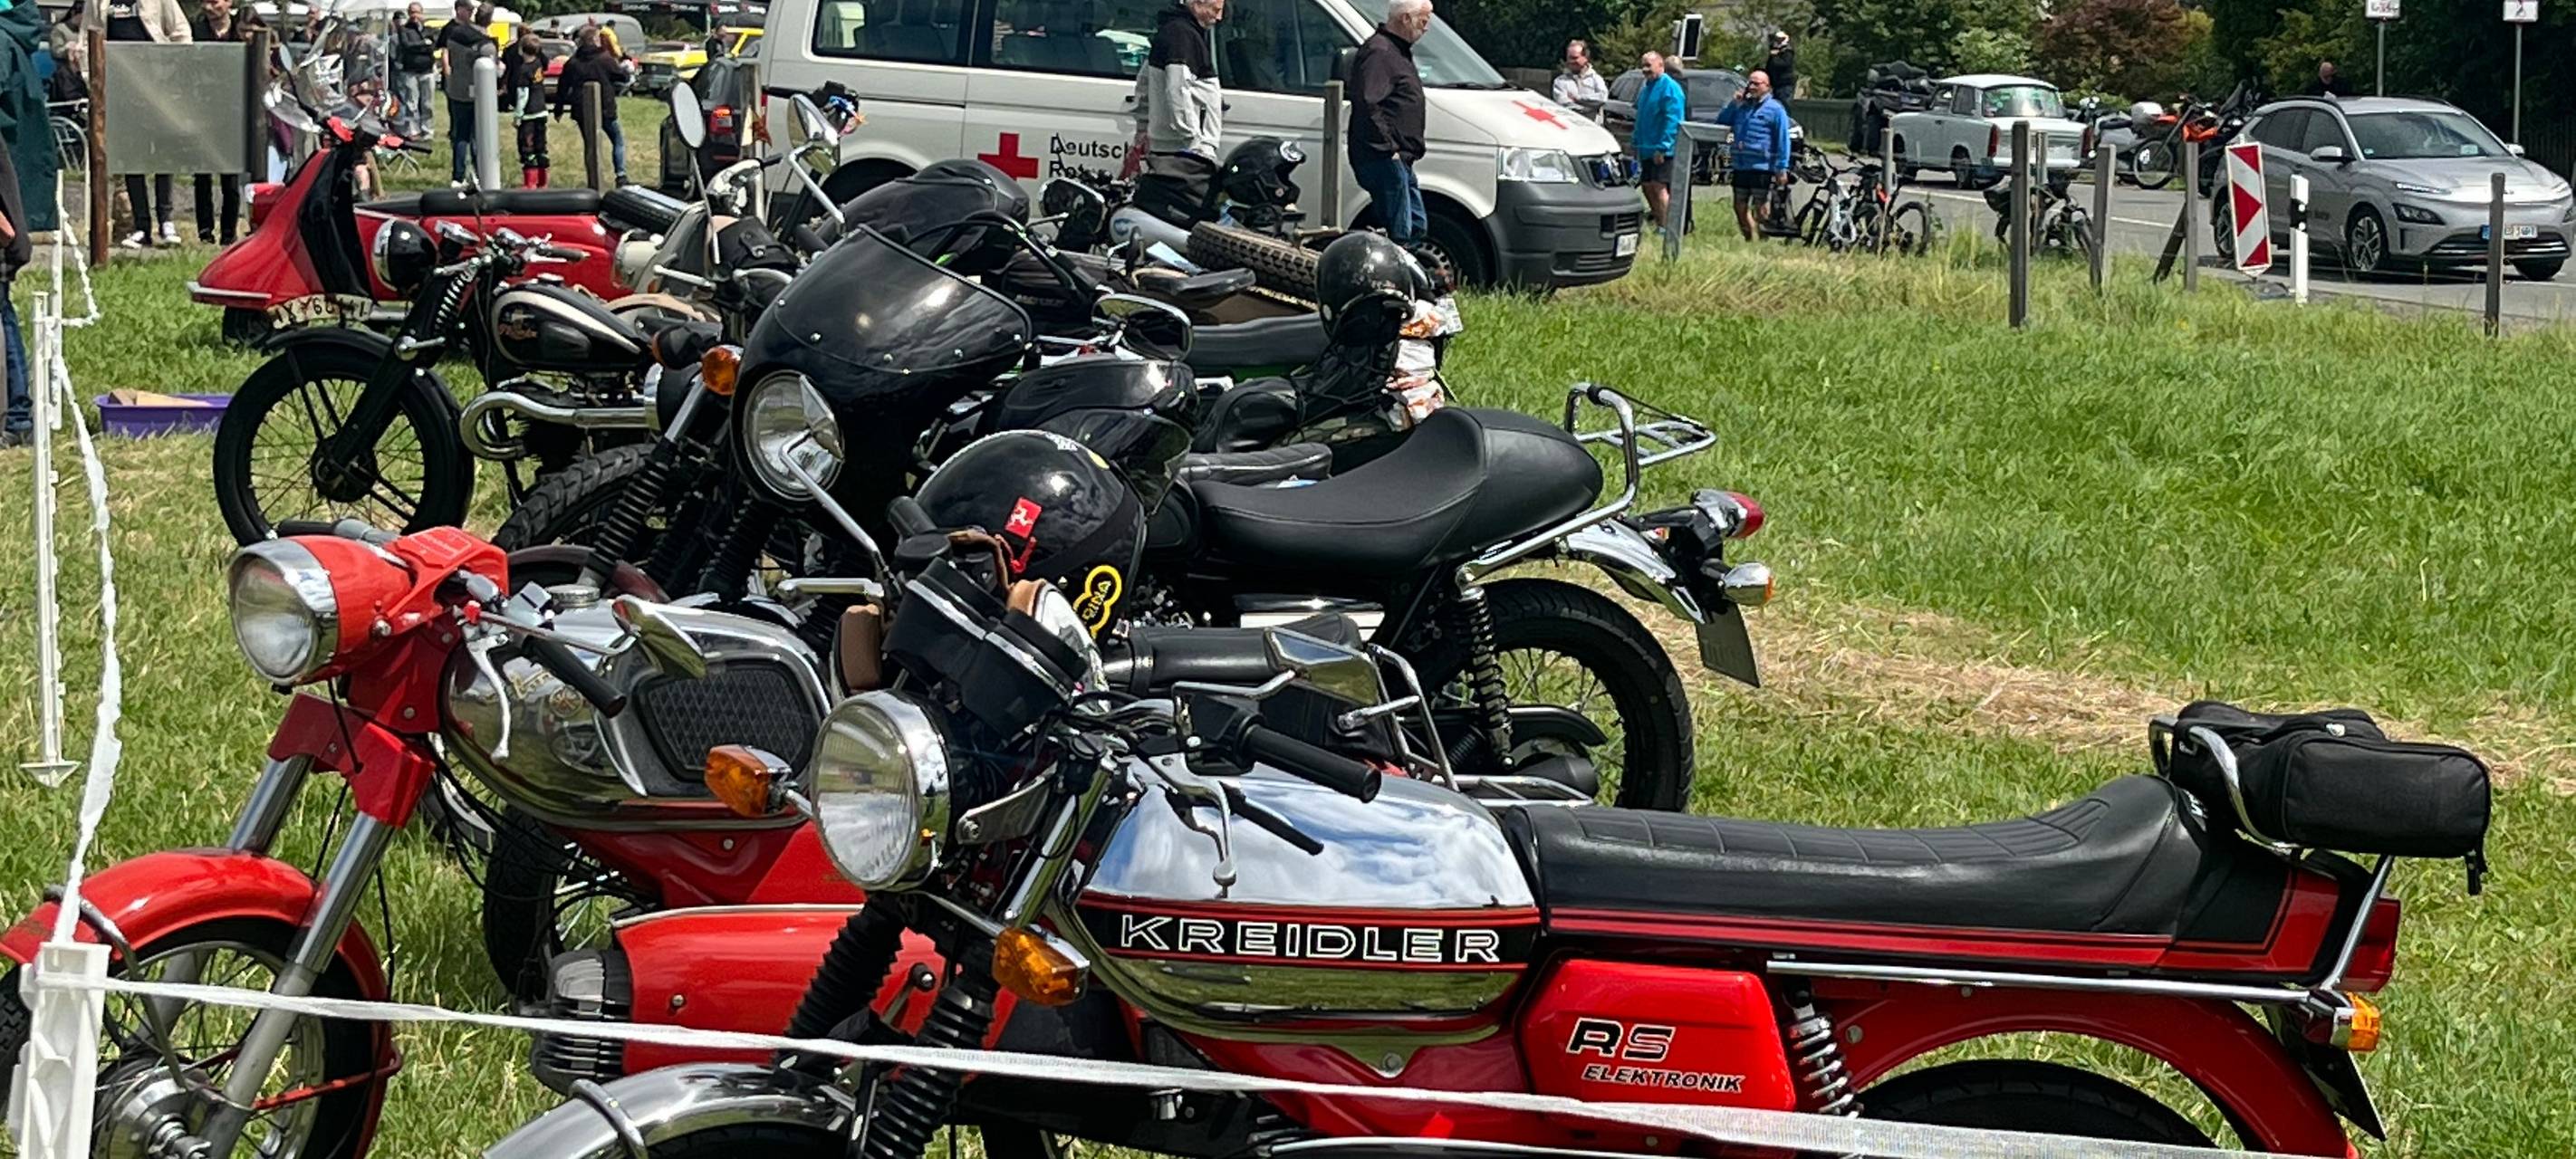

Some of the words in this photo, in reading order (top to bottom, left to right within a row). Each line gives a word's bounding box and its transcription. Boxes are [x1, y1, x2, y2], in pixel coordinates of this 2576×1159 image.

[1121, 915, 1500, 962] KREIDLER
[1565, 1017, 1677, 1062] RS
[1581, 1063, 1745, 1093] ELEKTRONIK
